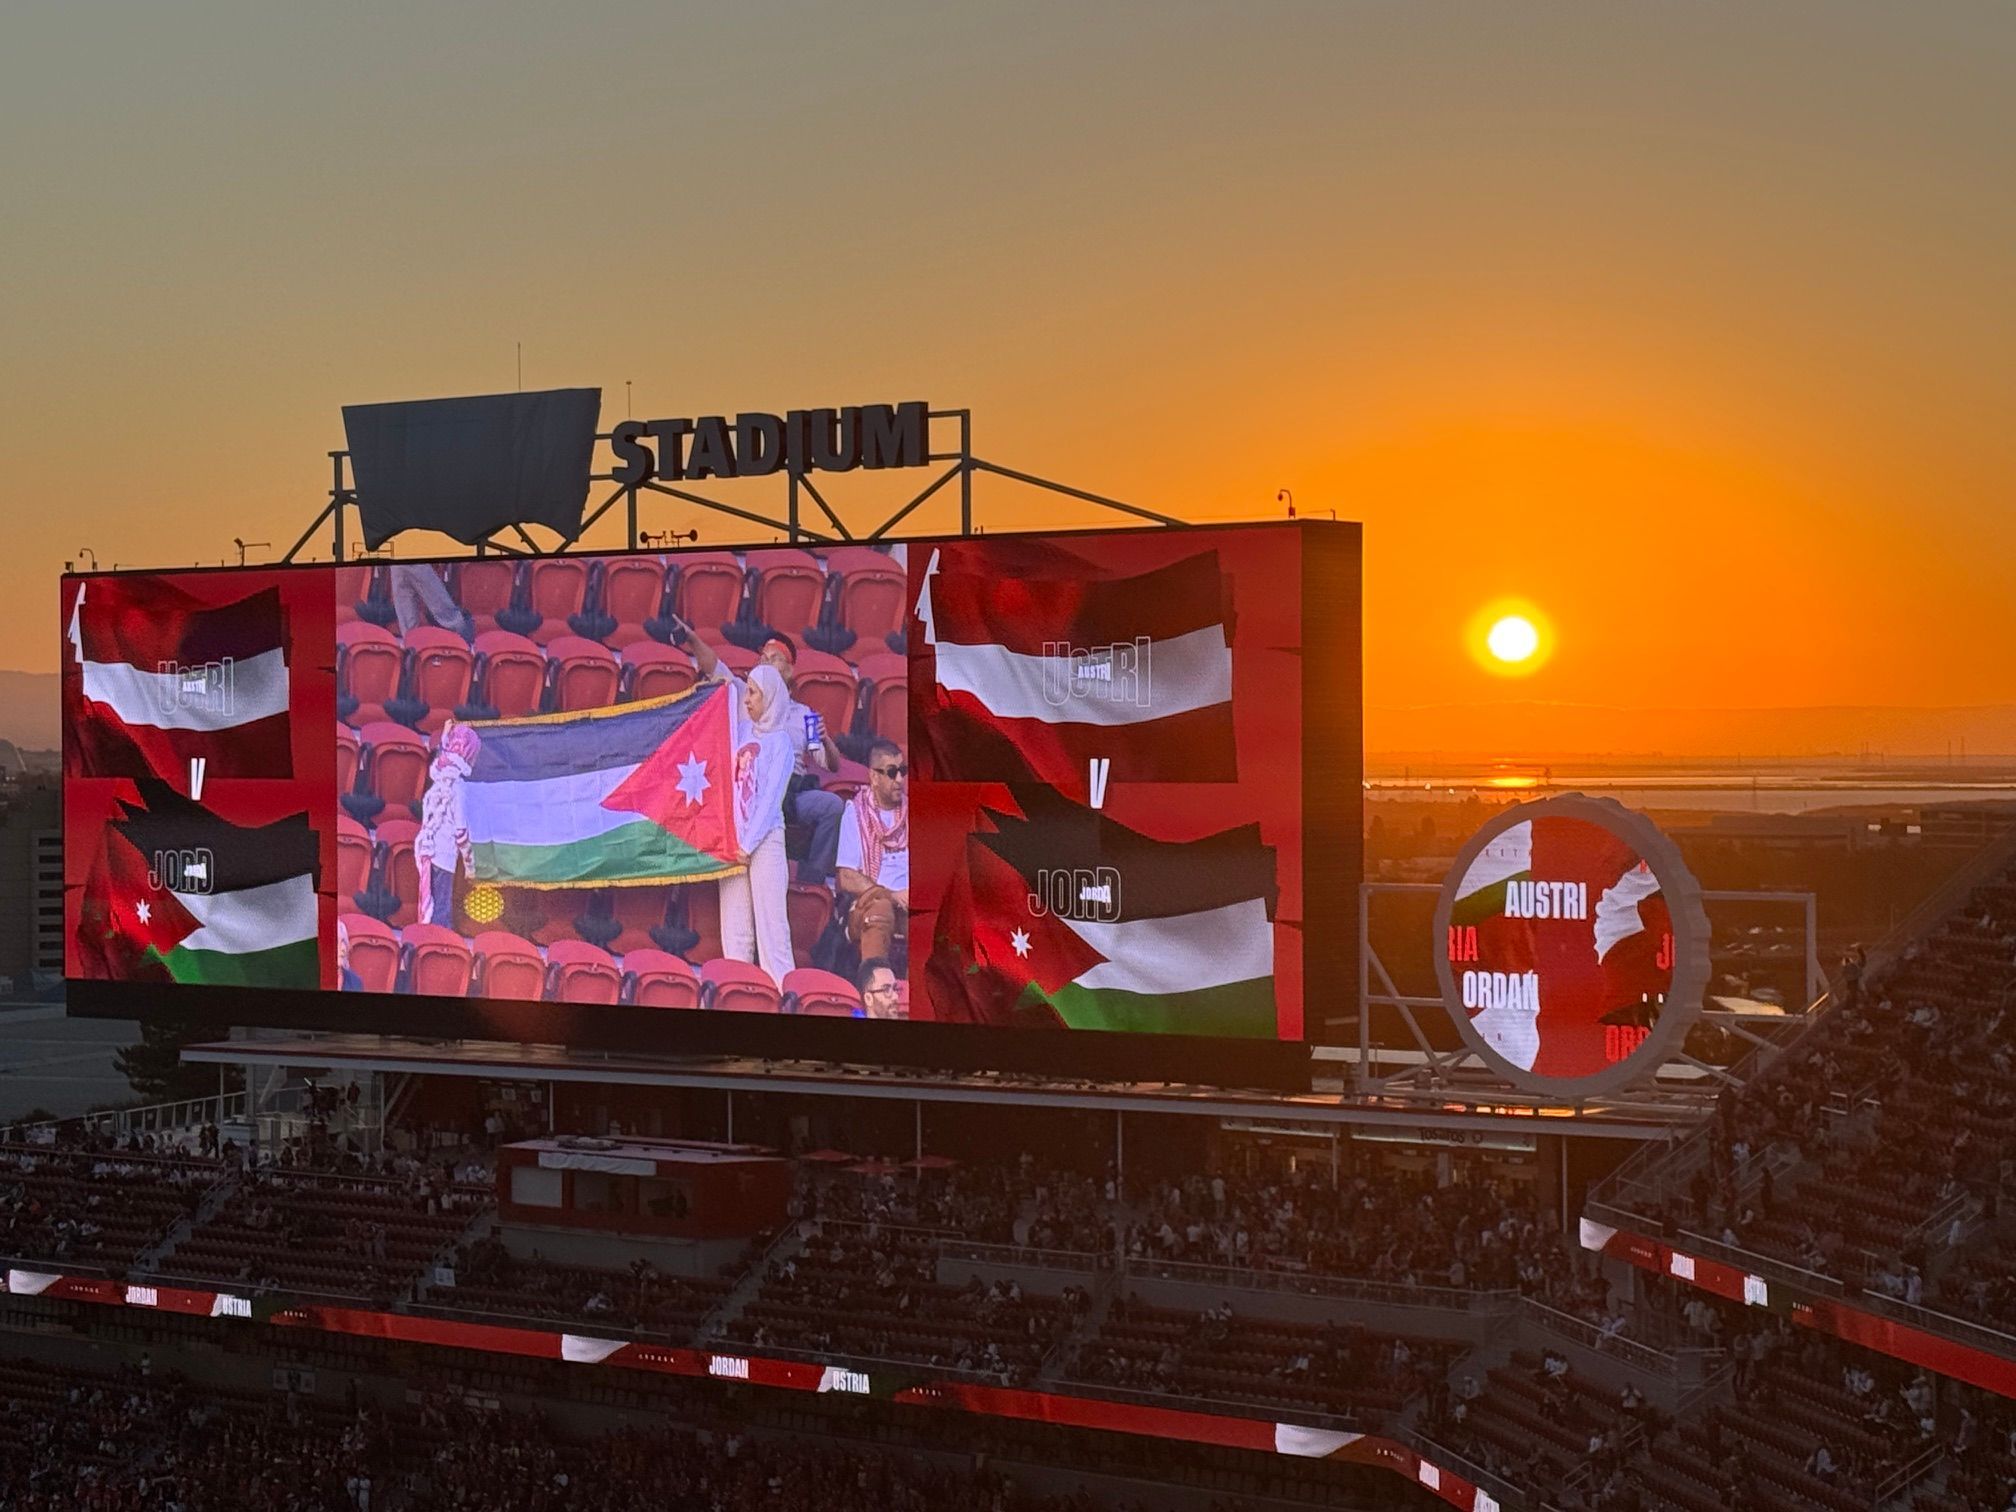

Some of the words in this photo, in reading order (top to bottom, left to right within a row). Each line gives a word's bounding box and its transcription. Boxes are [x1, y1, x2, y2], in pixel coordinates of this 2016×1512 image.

[612, 401, 929, 488] STADIUM
[191, 757, 206, 801] V
[1089, 758, 1111, 809] V
[1504, 881, 1588, 920] AUSTRI
[1462, 970, 1540, 1011] ORDAN
[708, 1355, 750, 1380] JORDAN
